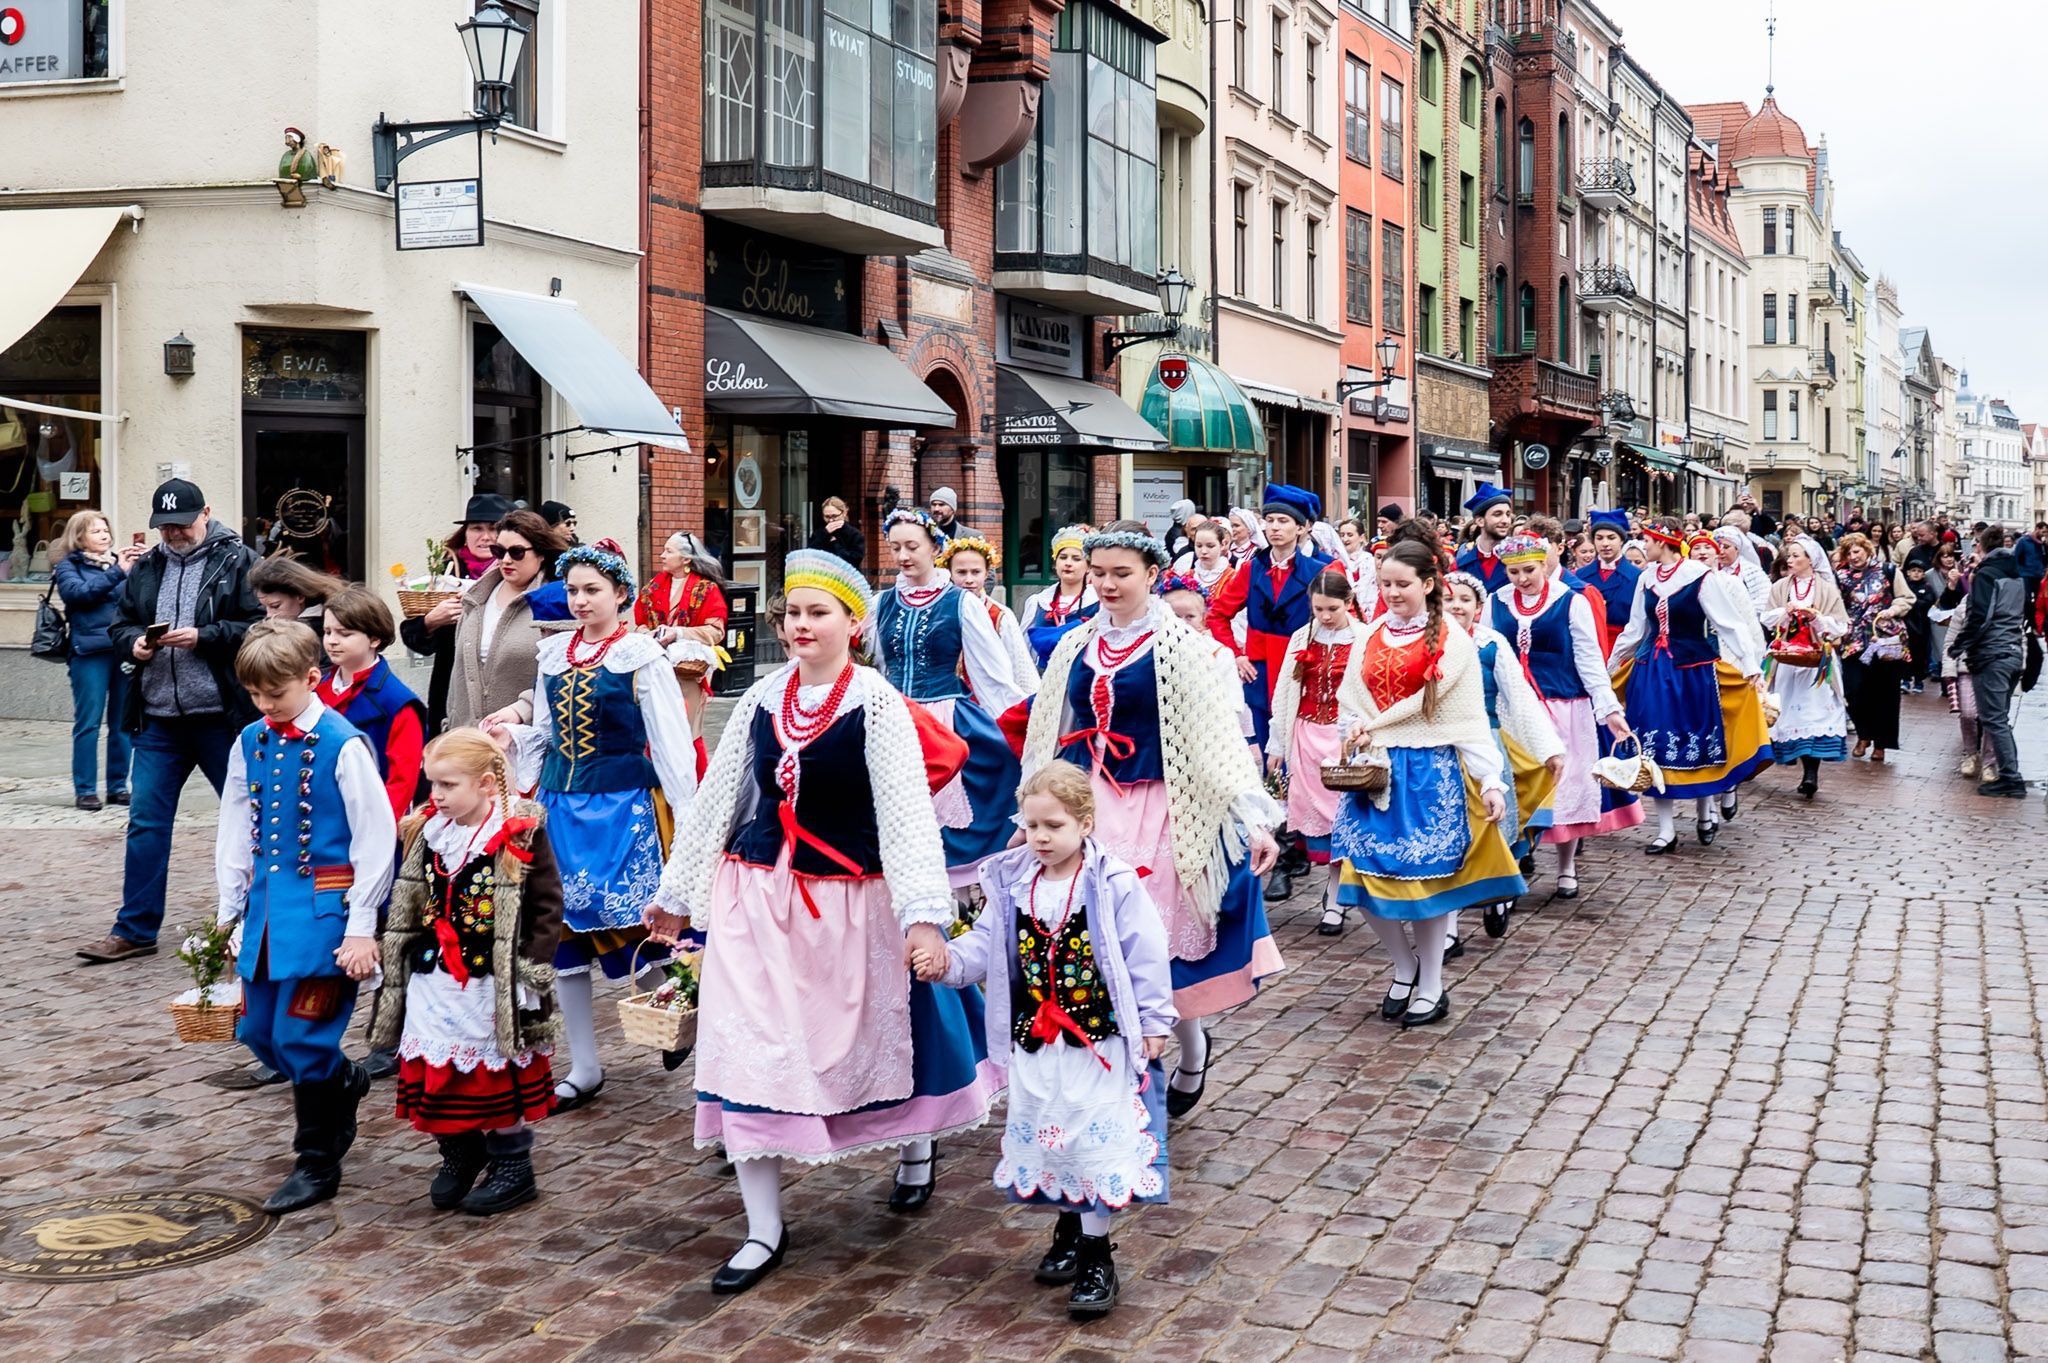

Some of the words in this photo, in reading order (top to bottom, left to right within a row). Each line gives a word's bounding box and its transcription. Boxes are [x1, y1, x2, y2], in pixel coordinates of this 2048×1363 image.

[829, 28, 865, 57] KWIAT
[896, 60, 934, 91] STUDIO
[742, 239, 815, 318] Lilou
[1013, 313, 1070, 345] KANTOR
[283, 355, 328, 373] EWA
[706, 358, 768, 391] Lilou
[1005, 415, 1057, 428] KANTOR
[1001, 434, 1061, 445] EXCHANGE
[161, 492, 177, 510] NY
